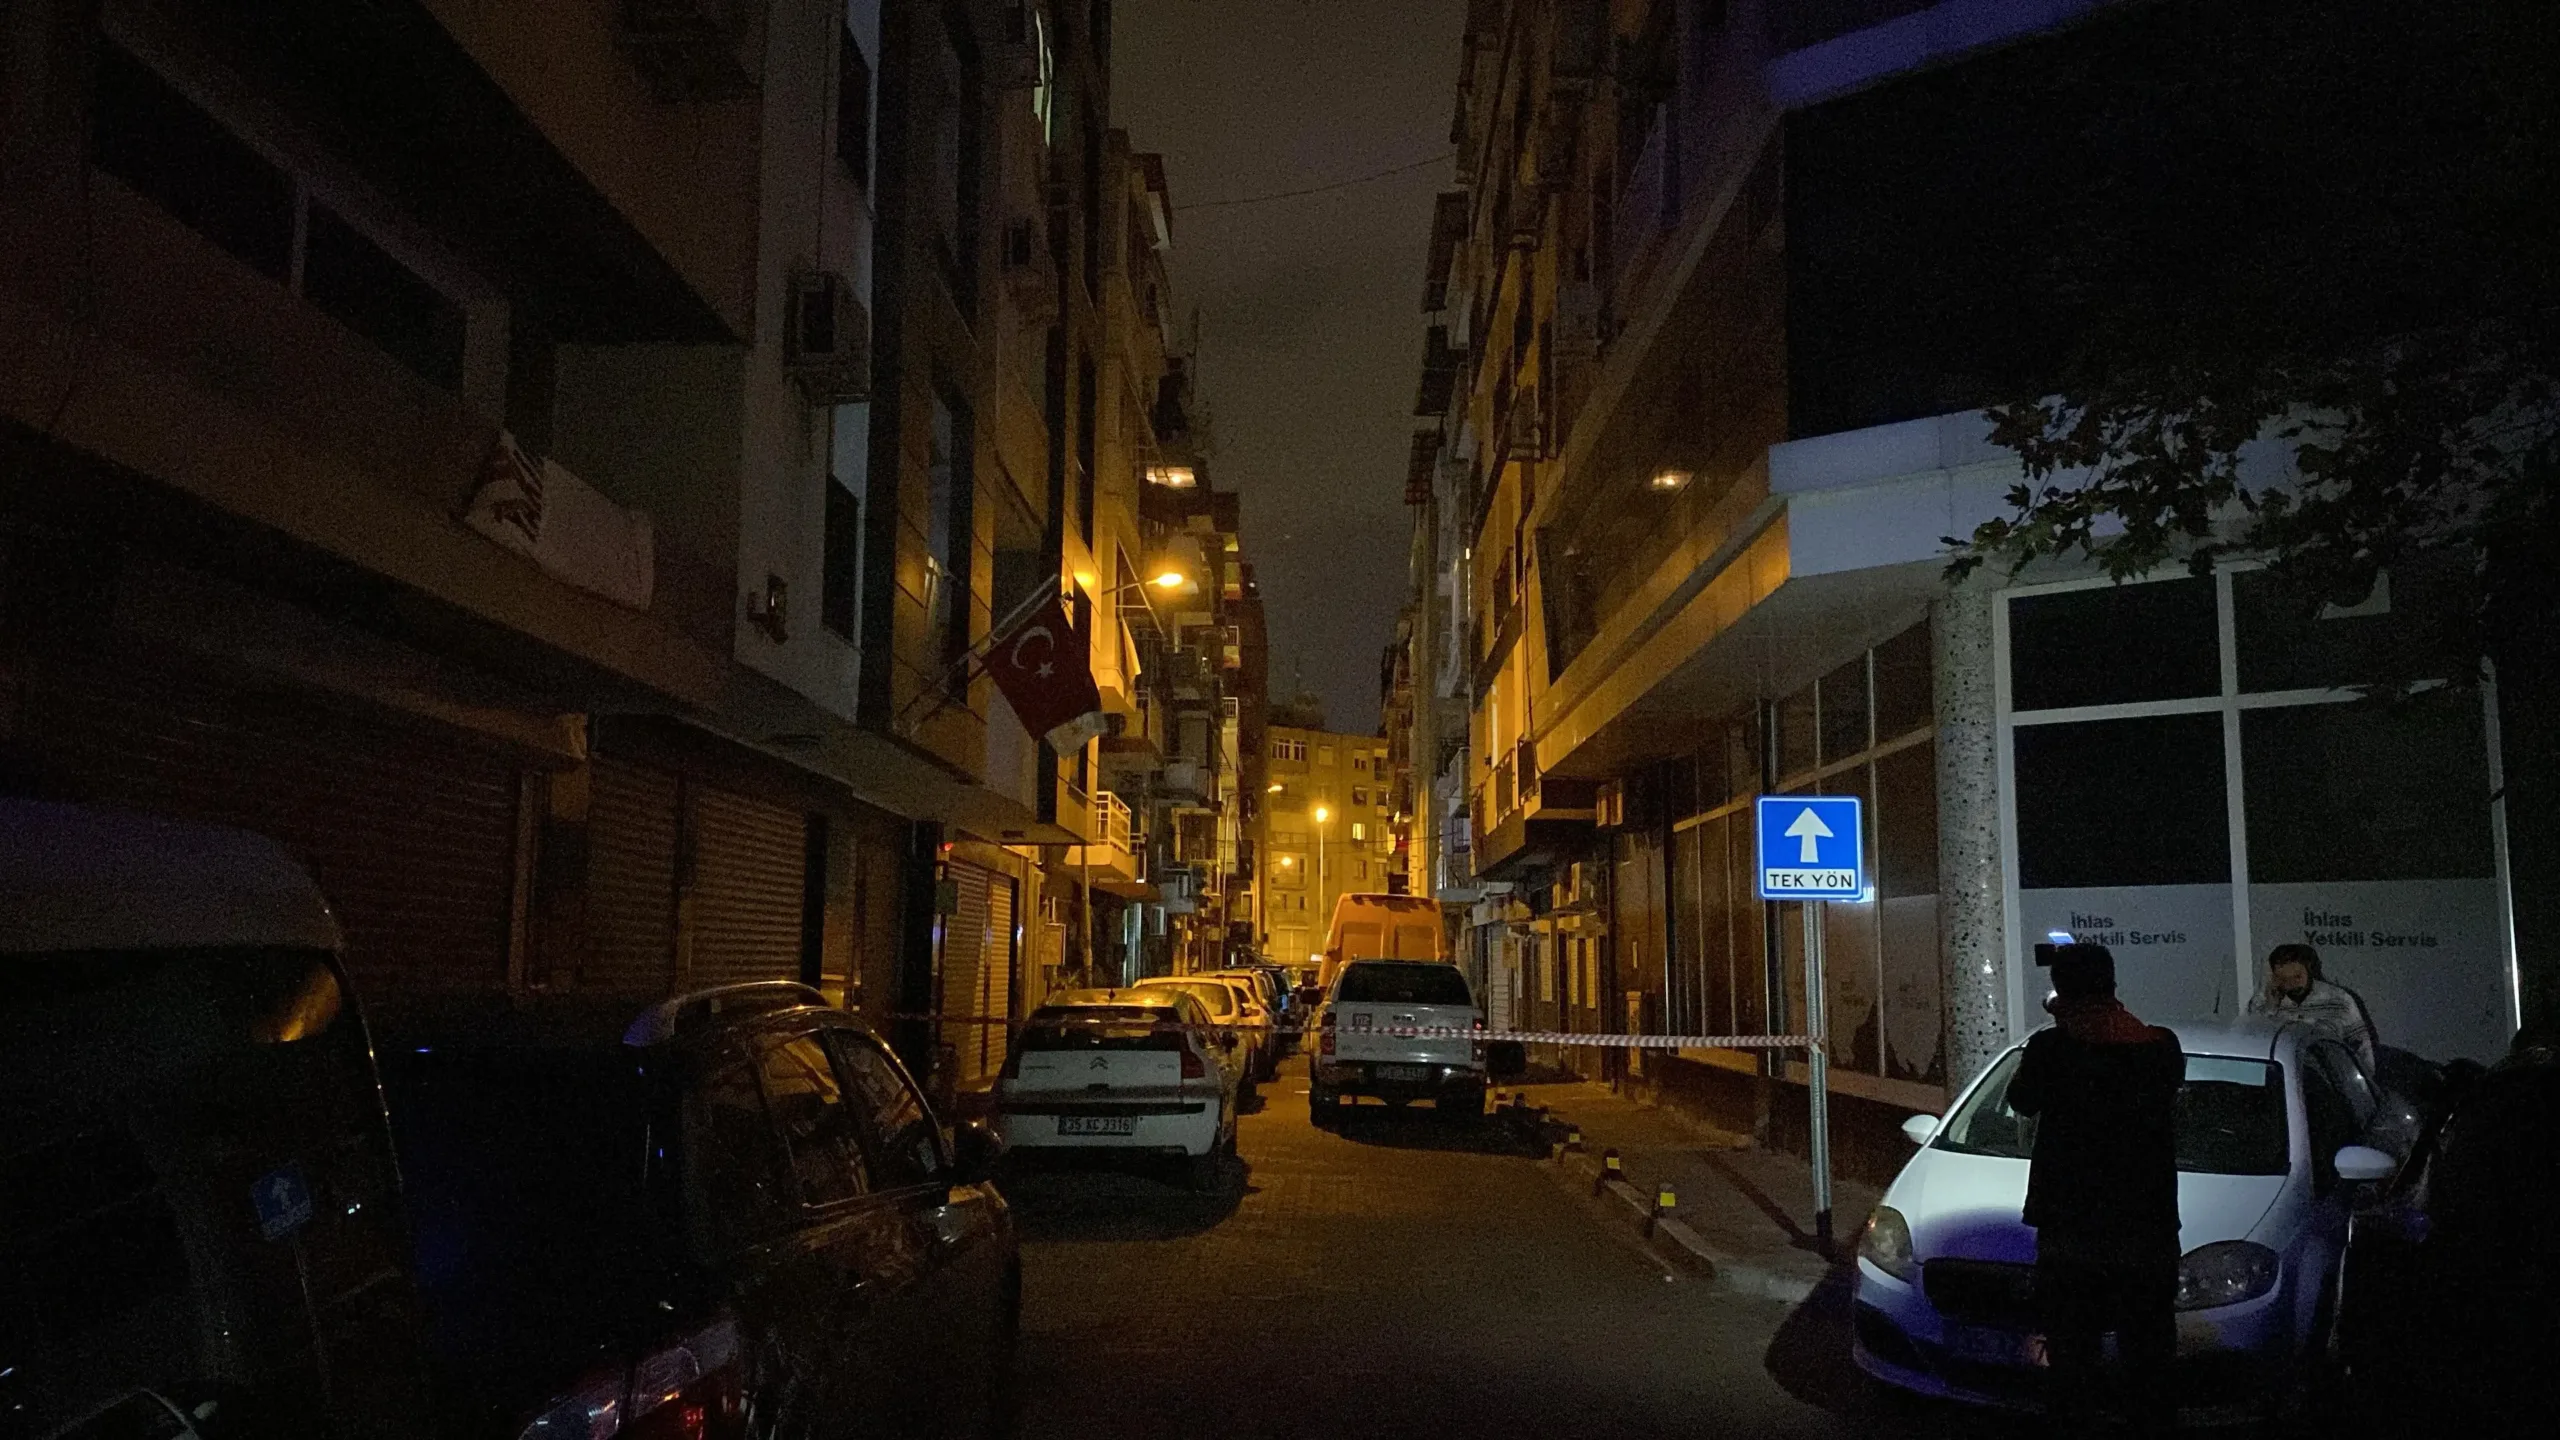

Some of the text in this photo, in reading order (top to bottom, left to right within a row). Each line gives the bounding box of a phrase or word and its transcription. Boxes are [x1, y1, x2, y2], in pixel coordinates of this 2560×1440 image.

[1769, 871, 1852, 888] TEK YÖN
[2070, 911, 2114, 928] İhlas
[2303, 906, 2352, 927] İhlas
[2130, 930, 2187, 945] Servis
[2303, 930, 2438, 947] Yetkili Servis
